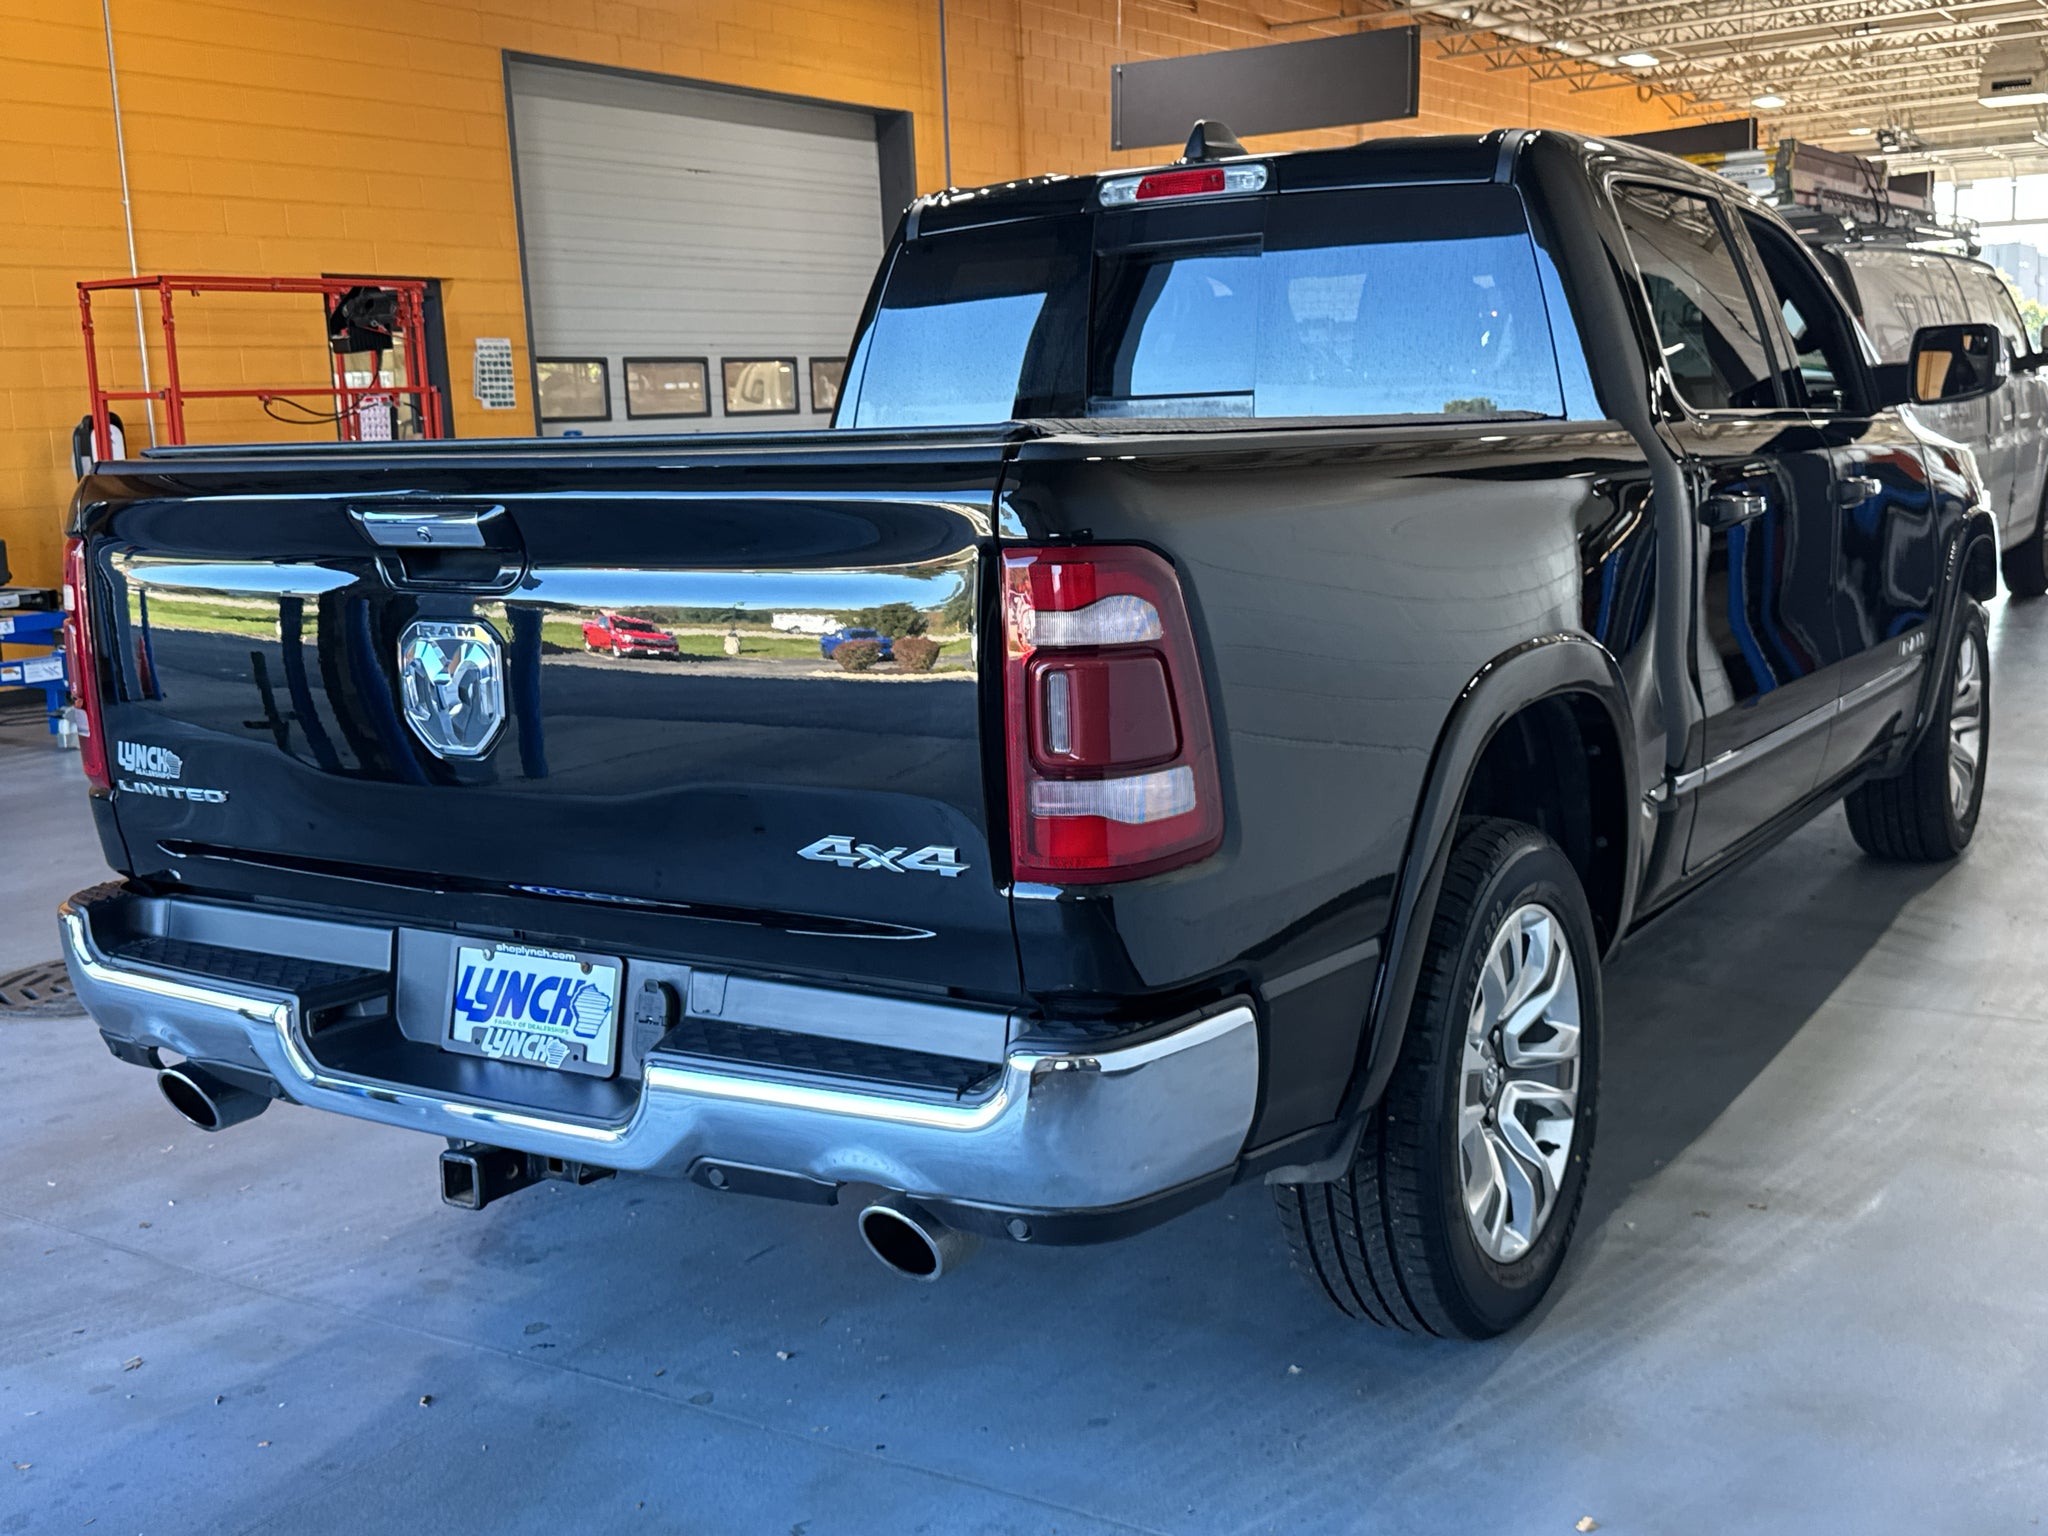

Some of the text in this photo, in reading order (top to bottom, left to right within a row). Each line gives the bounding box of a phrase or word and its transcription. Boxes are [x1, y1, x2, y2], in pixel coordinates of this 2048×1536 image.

[415, 625, 476, 638] RAM
[117, 741, 167, 772] LYNCH
[118, 779, 229, 803] LIMITED
[496, 943, 576, 962] shoplynch.com
[456, 965, 586, 1027] LYNCH
[481, 1028, 554, 1060] LYNCH
